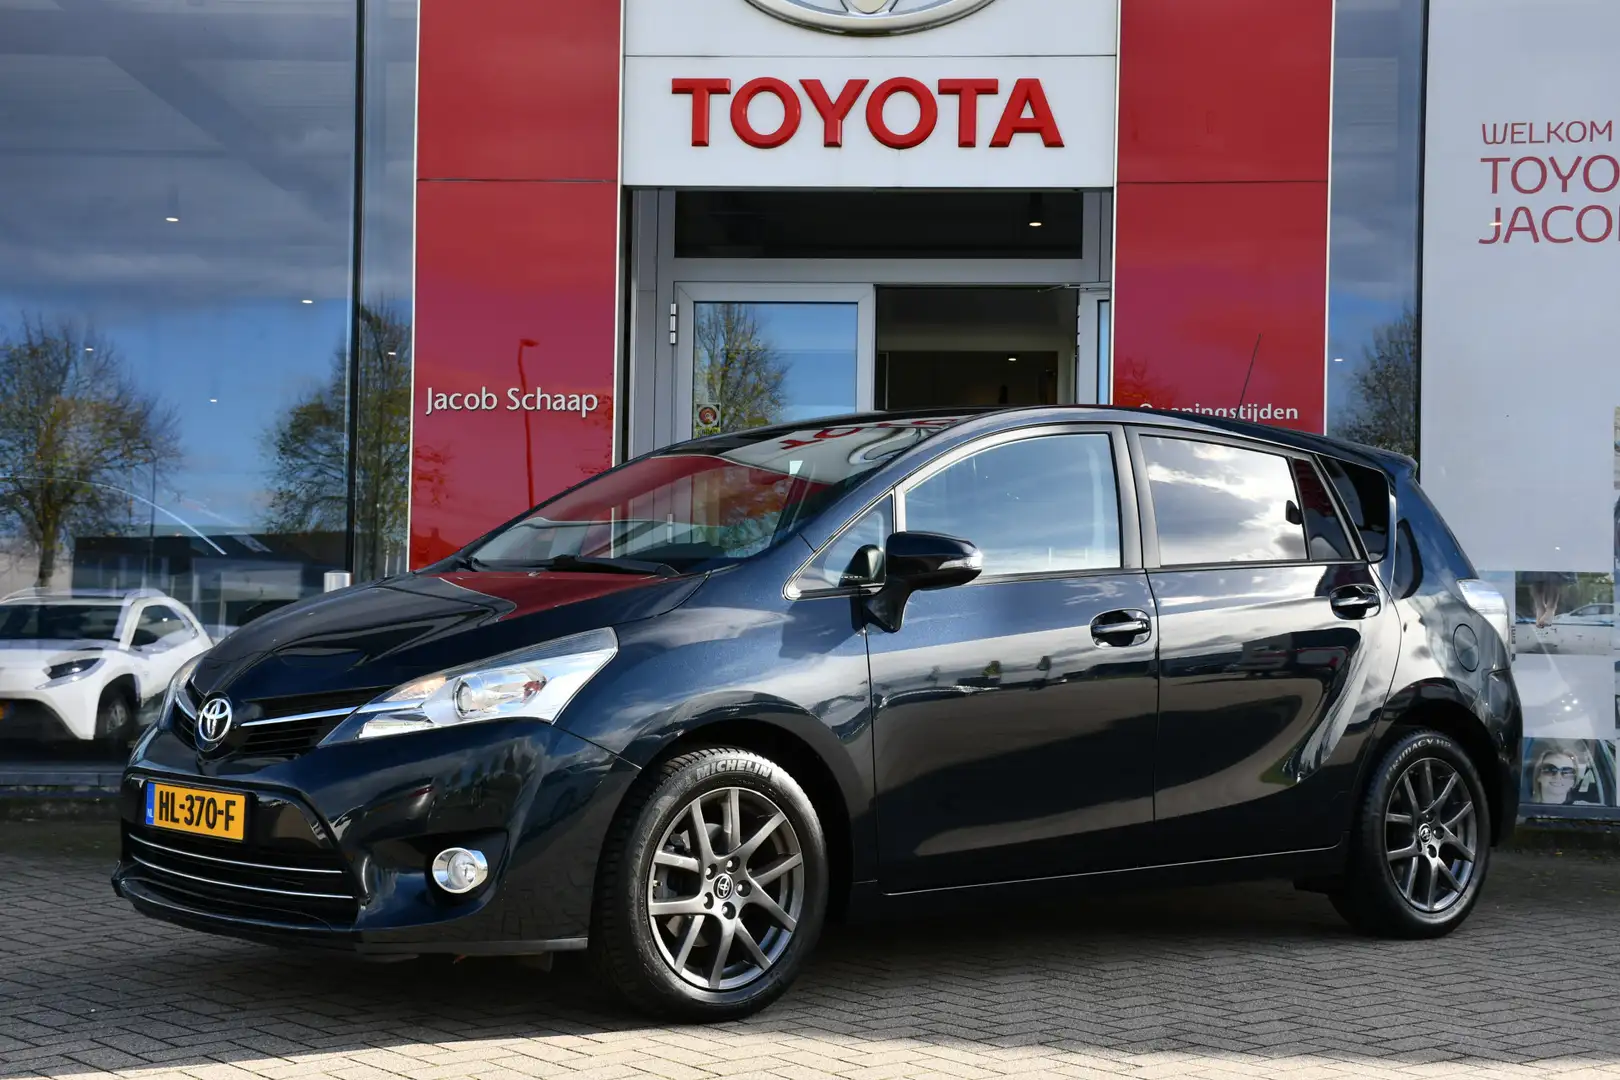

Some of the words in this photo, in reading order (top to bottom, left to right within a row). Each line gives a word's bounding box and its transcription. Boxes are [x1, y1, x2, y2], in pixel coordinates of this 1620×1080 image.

[671, 77, 1064, 149] TOYOTA
[1482, 120, 1612, 145] WELKOM
[1480, 154, 1620, 194] TOYO
[1478, 205, 1620, 244] JACO
[425, 386, 498, 416] Jacob
[506, 387, 598, 418] Schaap
[696, 759, 772, 781] MICHELIN
[158, 790, 236, 832] HL-370-F
